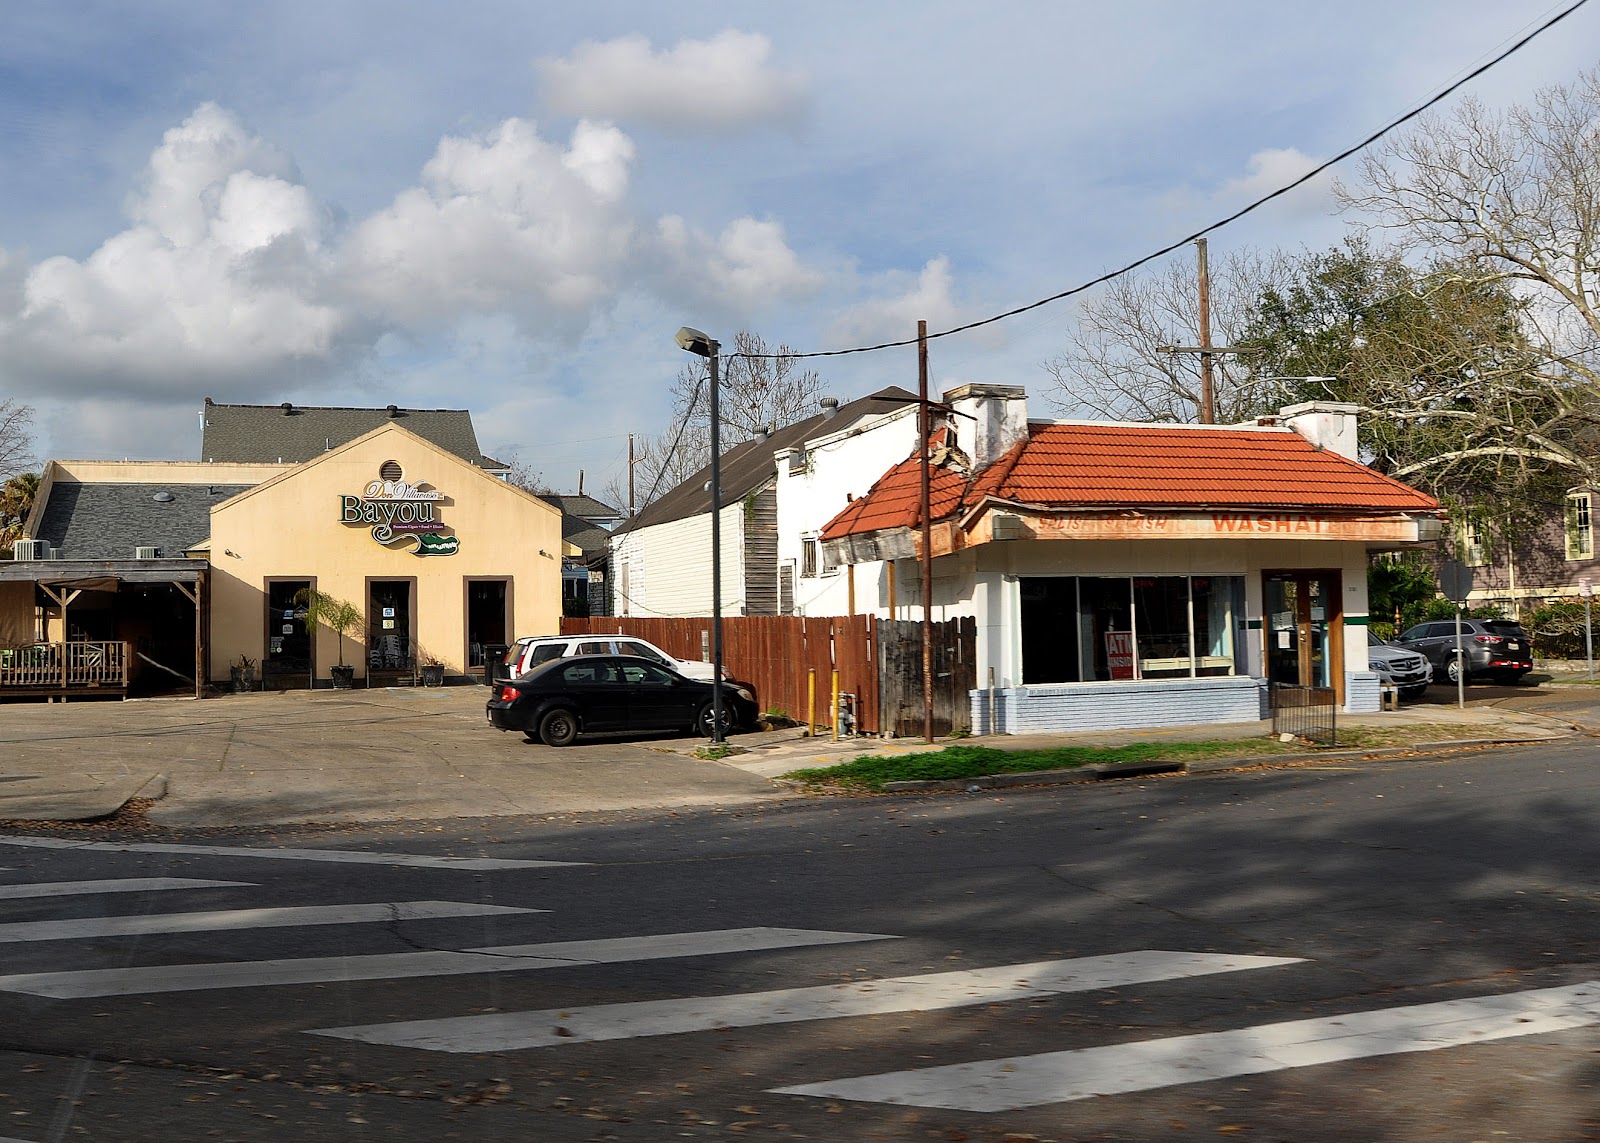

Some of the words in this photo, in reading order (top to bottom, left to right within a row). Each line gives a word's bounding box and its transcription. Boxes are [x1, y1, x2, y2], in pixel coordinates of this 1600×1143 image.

[363, 480, 394, 499] Don
[337, 495, 434, 539] Bayou
[1110, 656, 1133, 667] INSID
